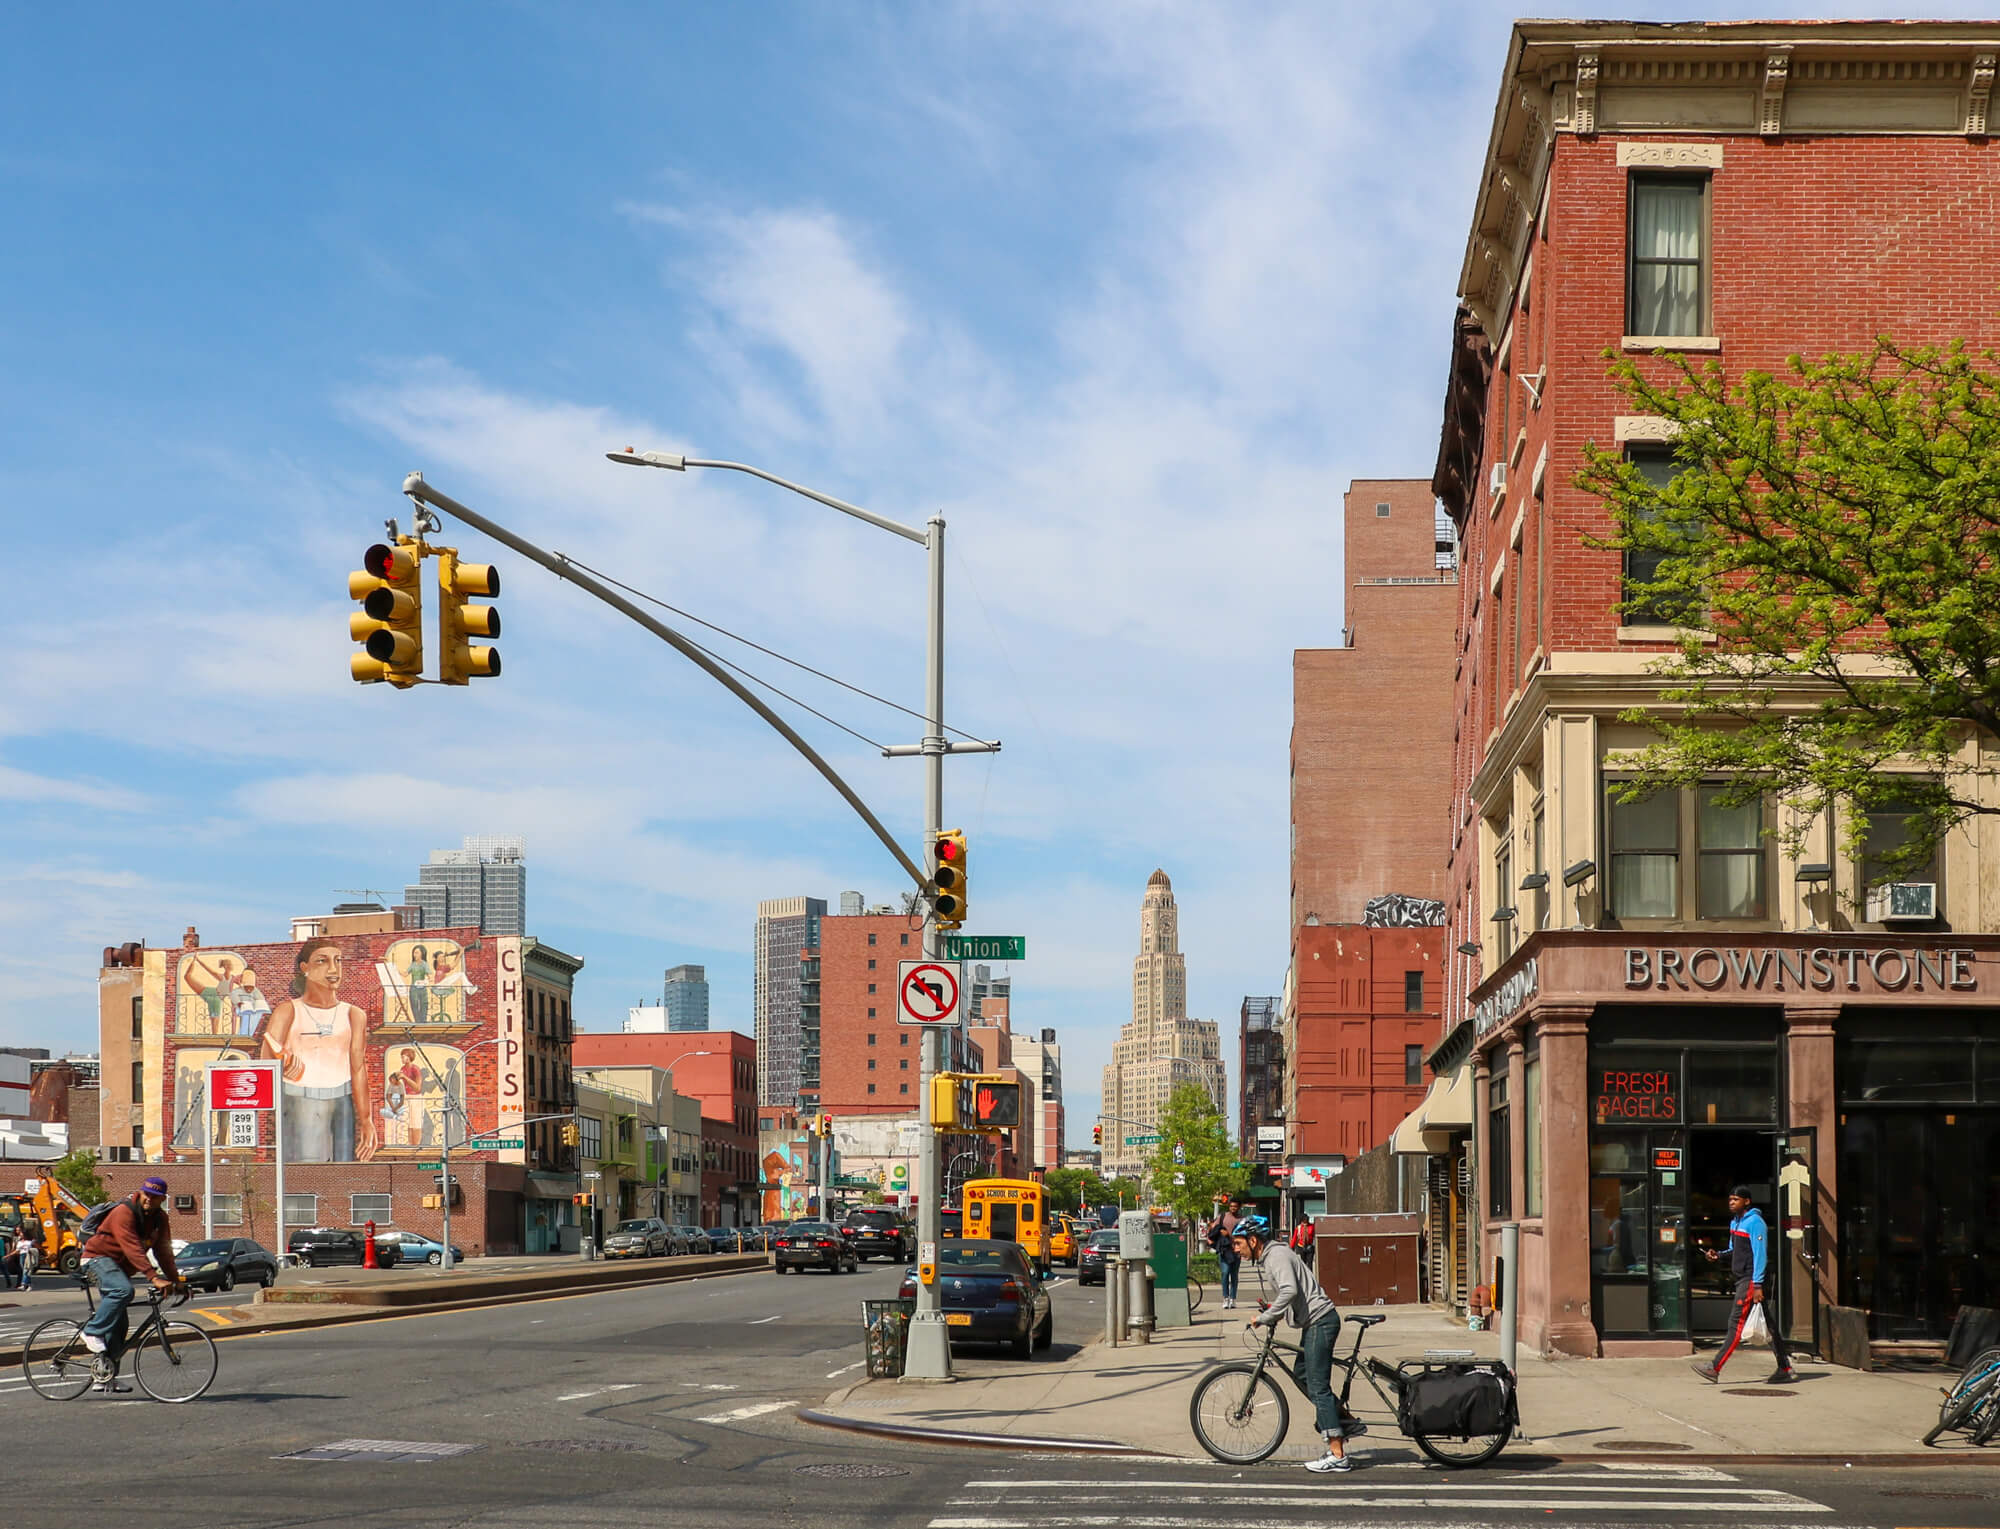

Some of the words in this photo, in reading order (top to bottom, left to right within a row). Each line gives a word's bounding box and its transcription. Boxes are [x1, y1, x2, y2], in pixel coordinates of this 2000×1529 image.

[951, 938, 1000, 957] Union
[1008, 939, 1018, 951] St
[1624, 948, 1977, 988] BROWNSTONE
[1603, 1072, 1669, 1094] FRESH
[225, 1098, 260, 1107] Speedway
[1597, 1095, 1676, 1118] BAGELS
[478, 1140, 508, 1148] Sackett
[1655, 1159, 1679, 1167] WANTED
[986, 1189, 1006, 1198] SCHOOL
[1007, 1189, 1019, 1198] BUS
